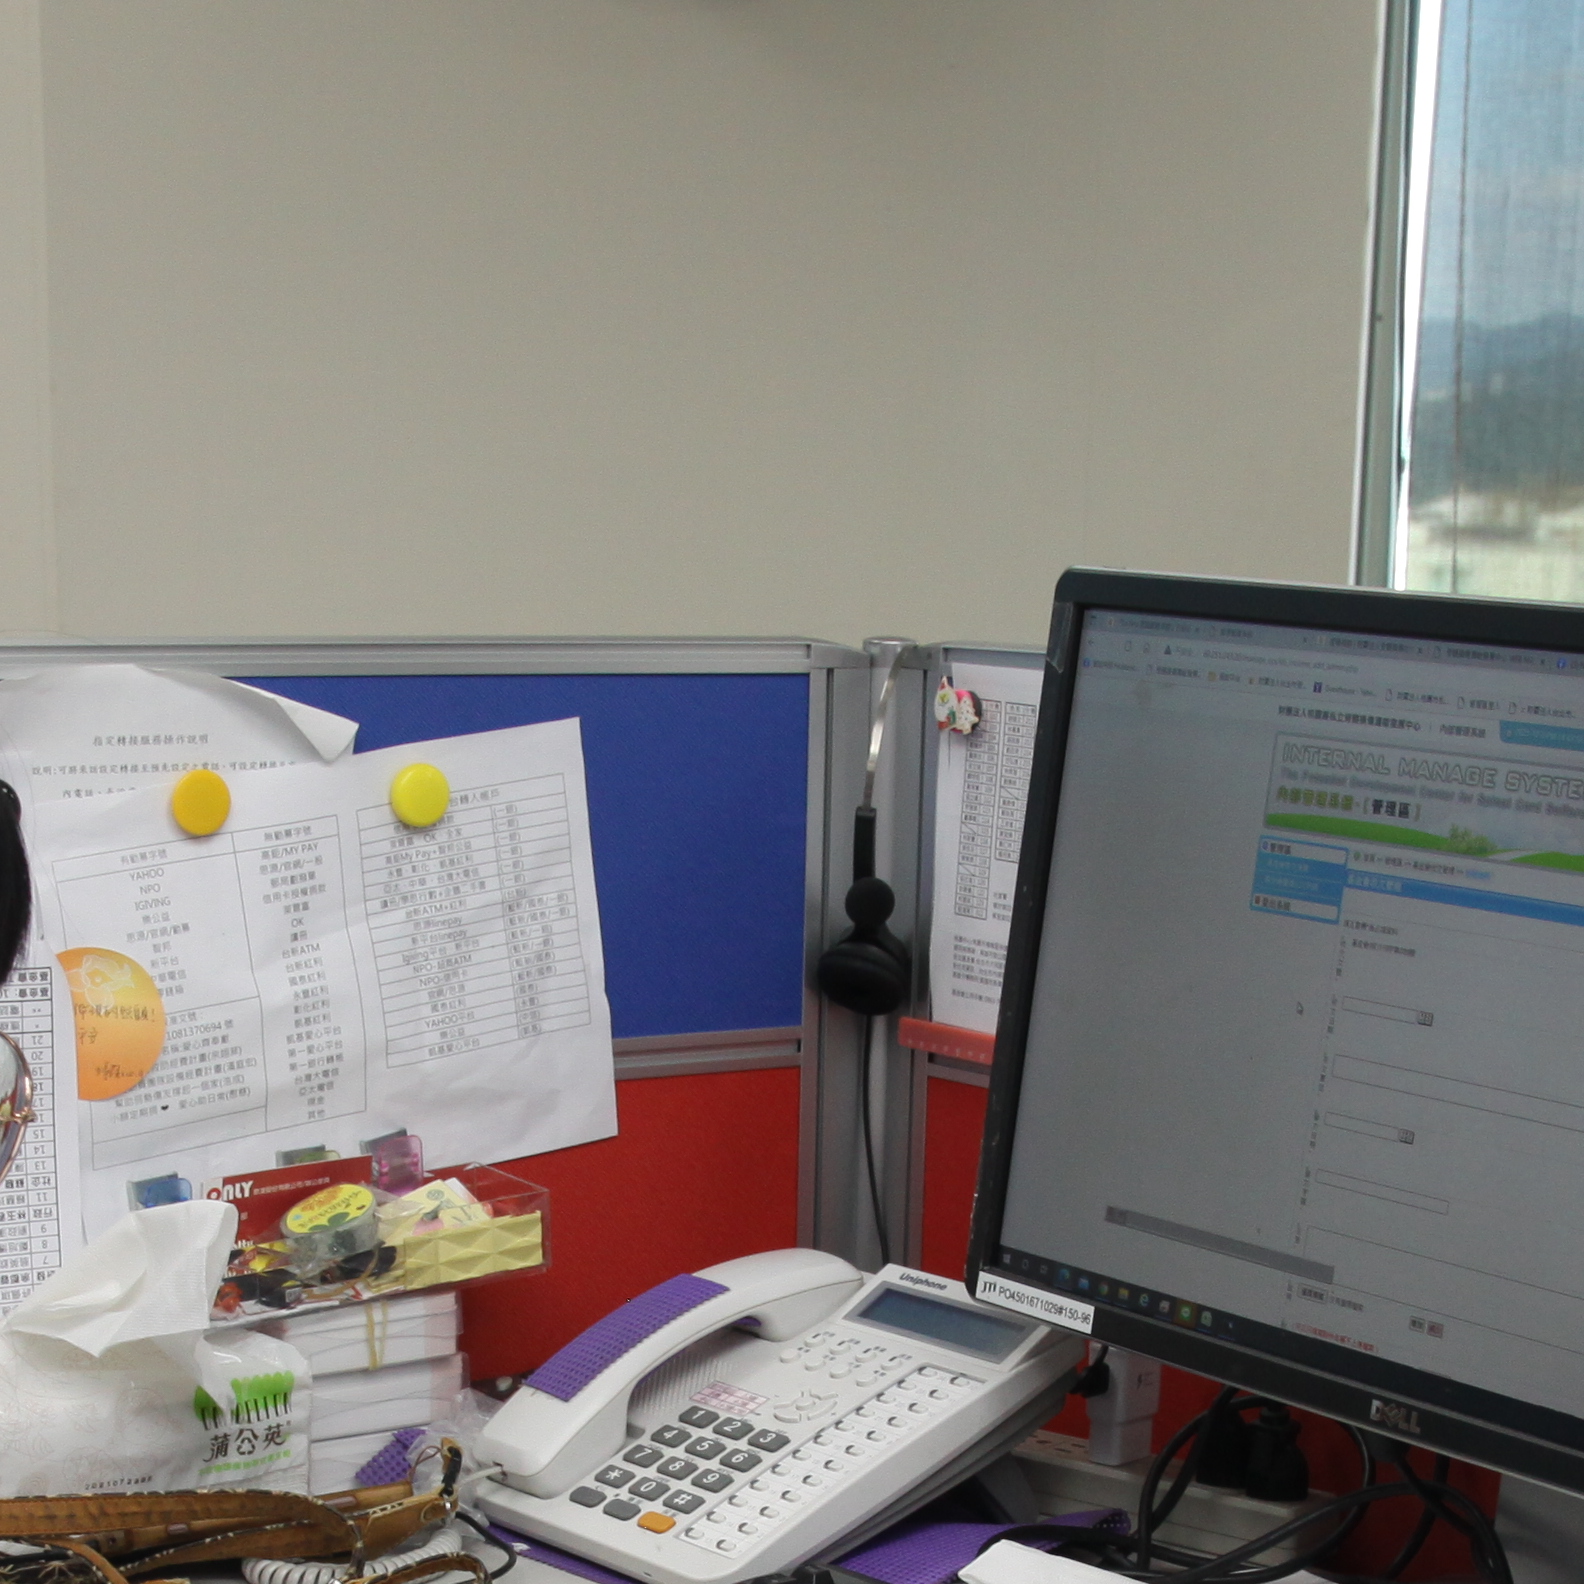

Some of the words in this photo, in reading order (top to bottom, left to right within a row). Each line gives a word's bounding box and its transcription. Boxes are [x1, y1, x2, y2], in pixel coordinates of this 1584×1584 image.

[1282, 741, 1391, 777] INTERNAL
[1398, 755, 1498, 790] MANAGE
[300, 843, 319, 854] PAY
[129, 867, 165, 881] YAHOO
[139, 884, 161, 895] NPO
[134, 897, 171, 911] IGIVING
[291, 918, 305, 928] OK
[282, 943, 321, 960] 台新ATM
[150, 956, 180, 969] 新平台
[32, 1035, 44, 1044] 21
[31, 1050, 45, 1061] 20
[32, 1066, 44, 1076] 19
[33, 1129, 45, 1138] 15
[33, 1145, 45, 1154] 14
[34, 1160, 47, 1170] 13
[36, 1193, 48, 1202] 11
[33, 1208, 53, 1218] 行政
[899, 1271, 948, 1292] Uniphone
[692, 1410, 705, 1420] 1
[1370, 1397, 1421, 1434] DELL
[724, 1421, 742, 1432] 2
[663, 1429, 679, 1439] 4
[759, 1433, 776, 1443] 3
[203, 1423, 286, 1463] 蒲公英
[696, 1440, 714, 1451] 5
[635, 1449, 653, 1458] 7
[731, 1453, 748, 1464] 6
[668, 1460, 685, 1471] 8
[702, 1472, 720, 1484] 9
[640, 1482, 657, 1492] 0
[673, 1494, 692, 1506] #
